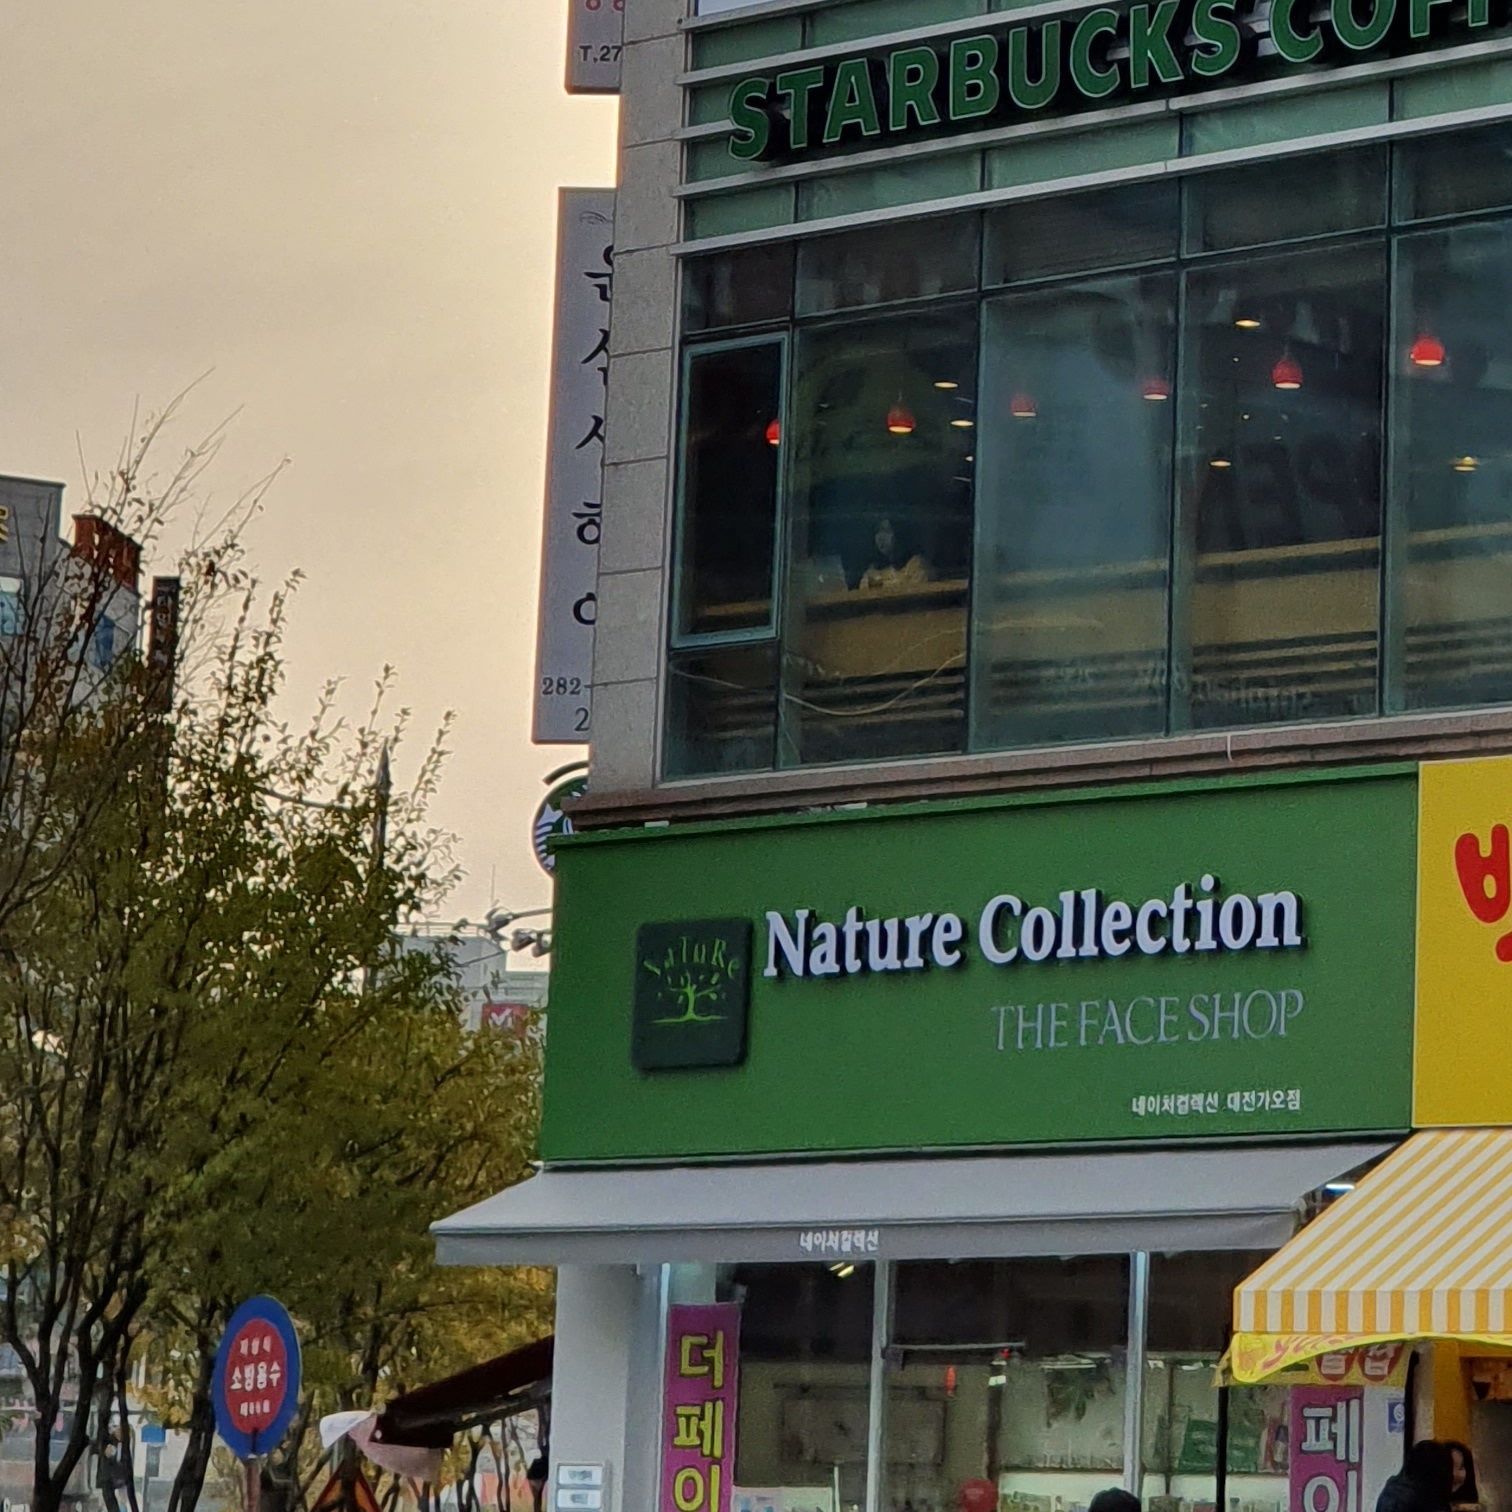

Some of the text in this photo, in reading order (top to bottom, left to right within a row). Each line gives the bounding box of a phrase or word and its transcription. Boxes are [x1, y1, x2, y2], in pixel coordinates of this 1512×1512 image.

[763, 872, 1305, 978] Nature Collection
[1187, 988, 1305, 1041] SHOP
[1226, 1088, 1302, 1113] 대전가오점
